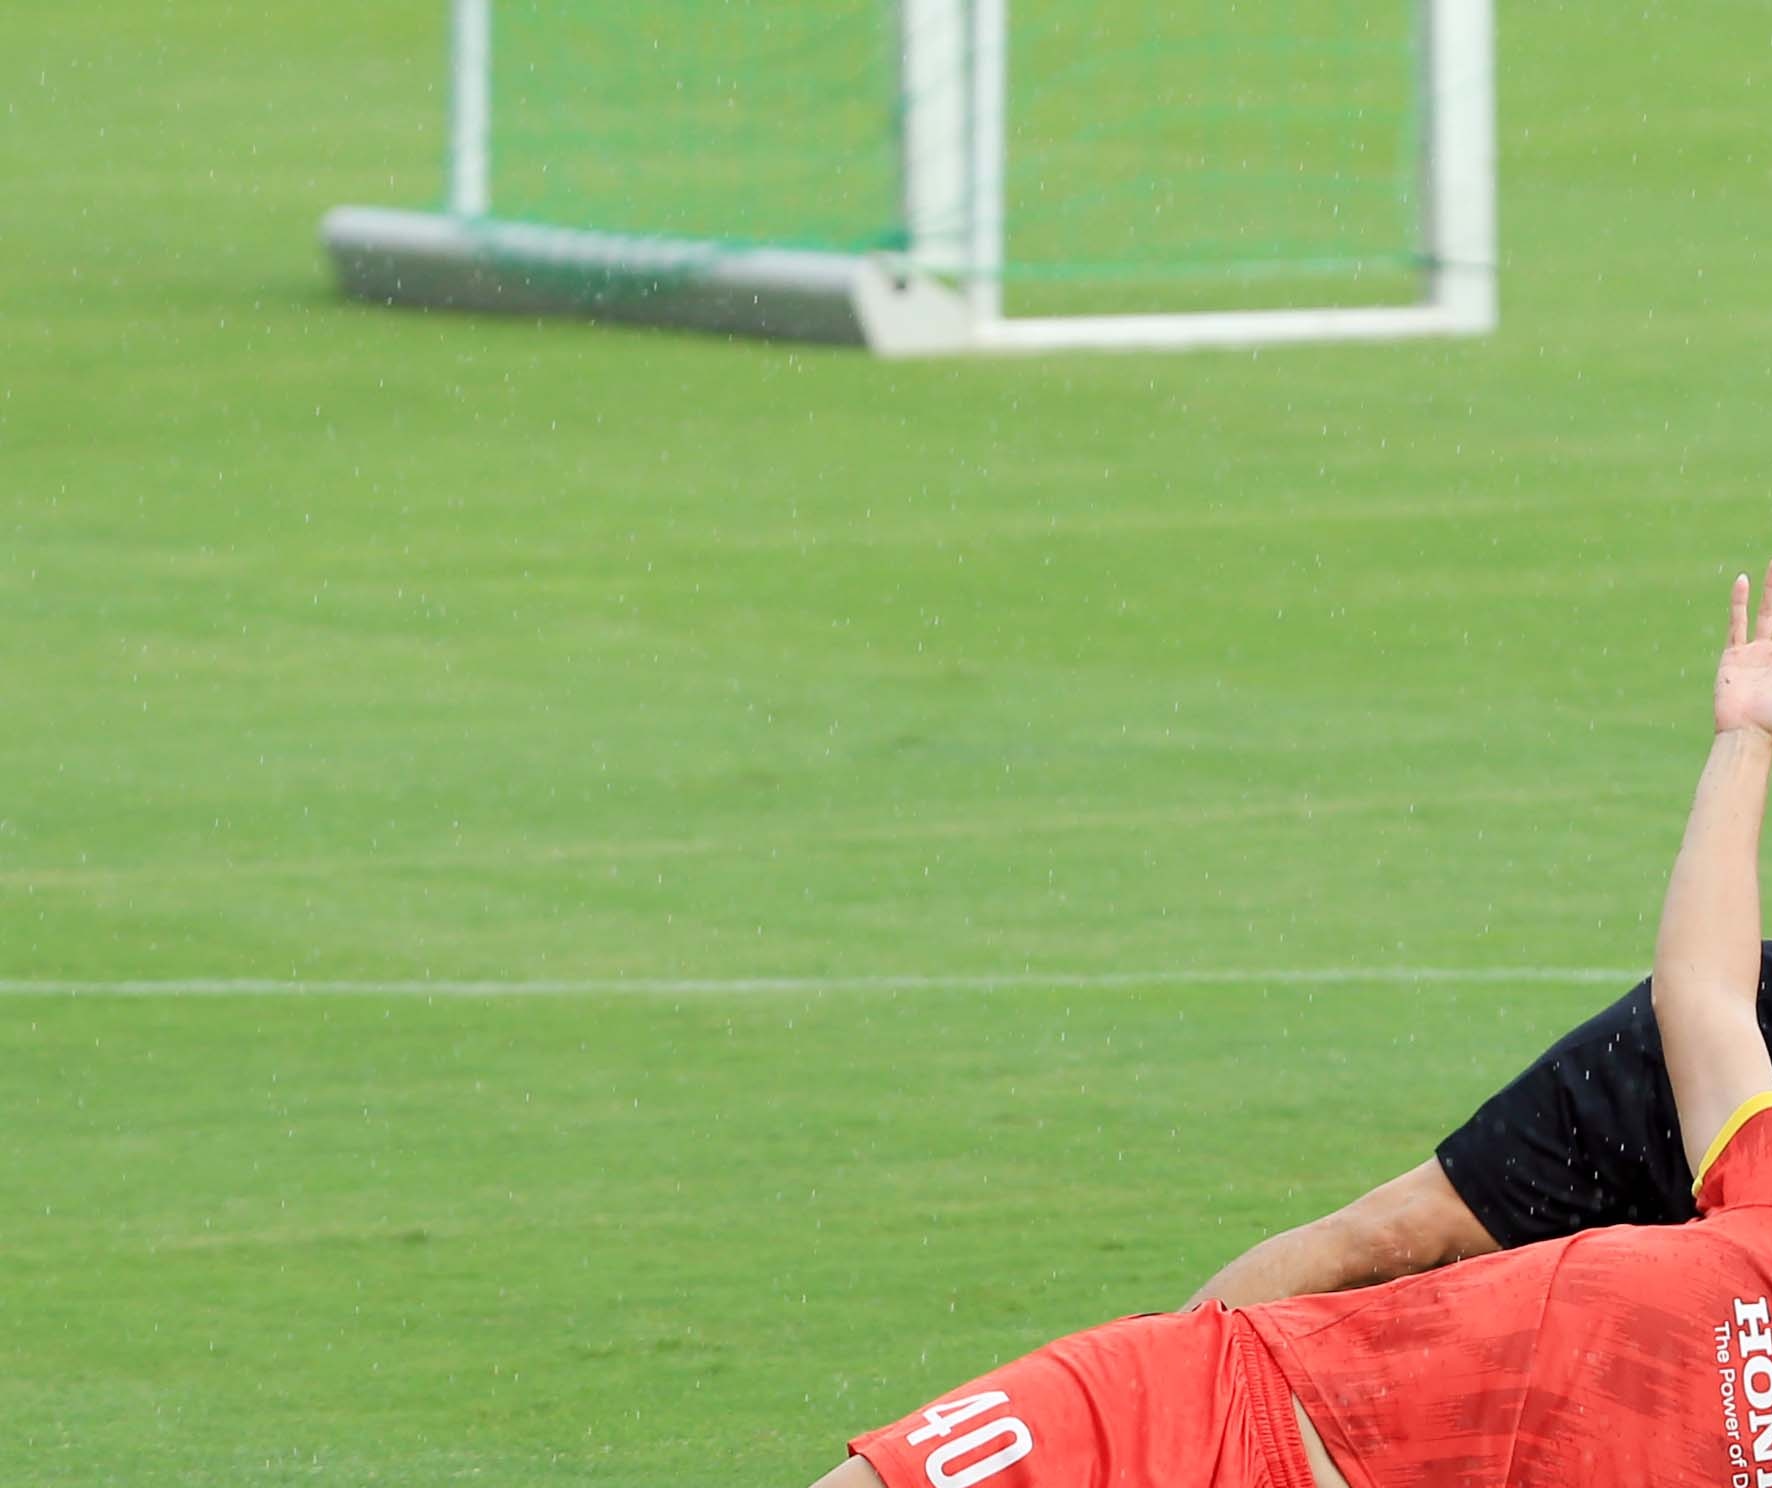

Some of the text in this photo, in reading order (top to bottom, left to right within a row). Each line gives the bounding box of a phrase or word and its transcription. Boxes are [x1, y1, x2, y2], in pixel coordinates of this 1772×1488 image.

[1713, 1320, 1732, 1363] The
[1718, 1368, 1740, 1441] Power
[1729, 1444, 1748, 1469] of
